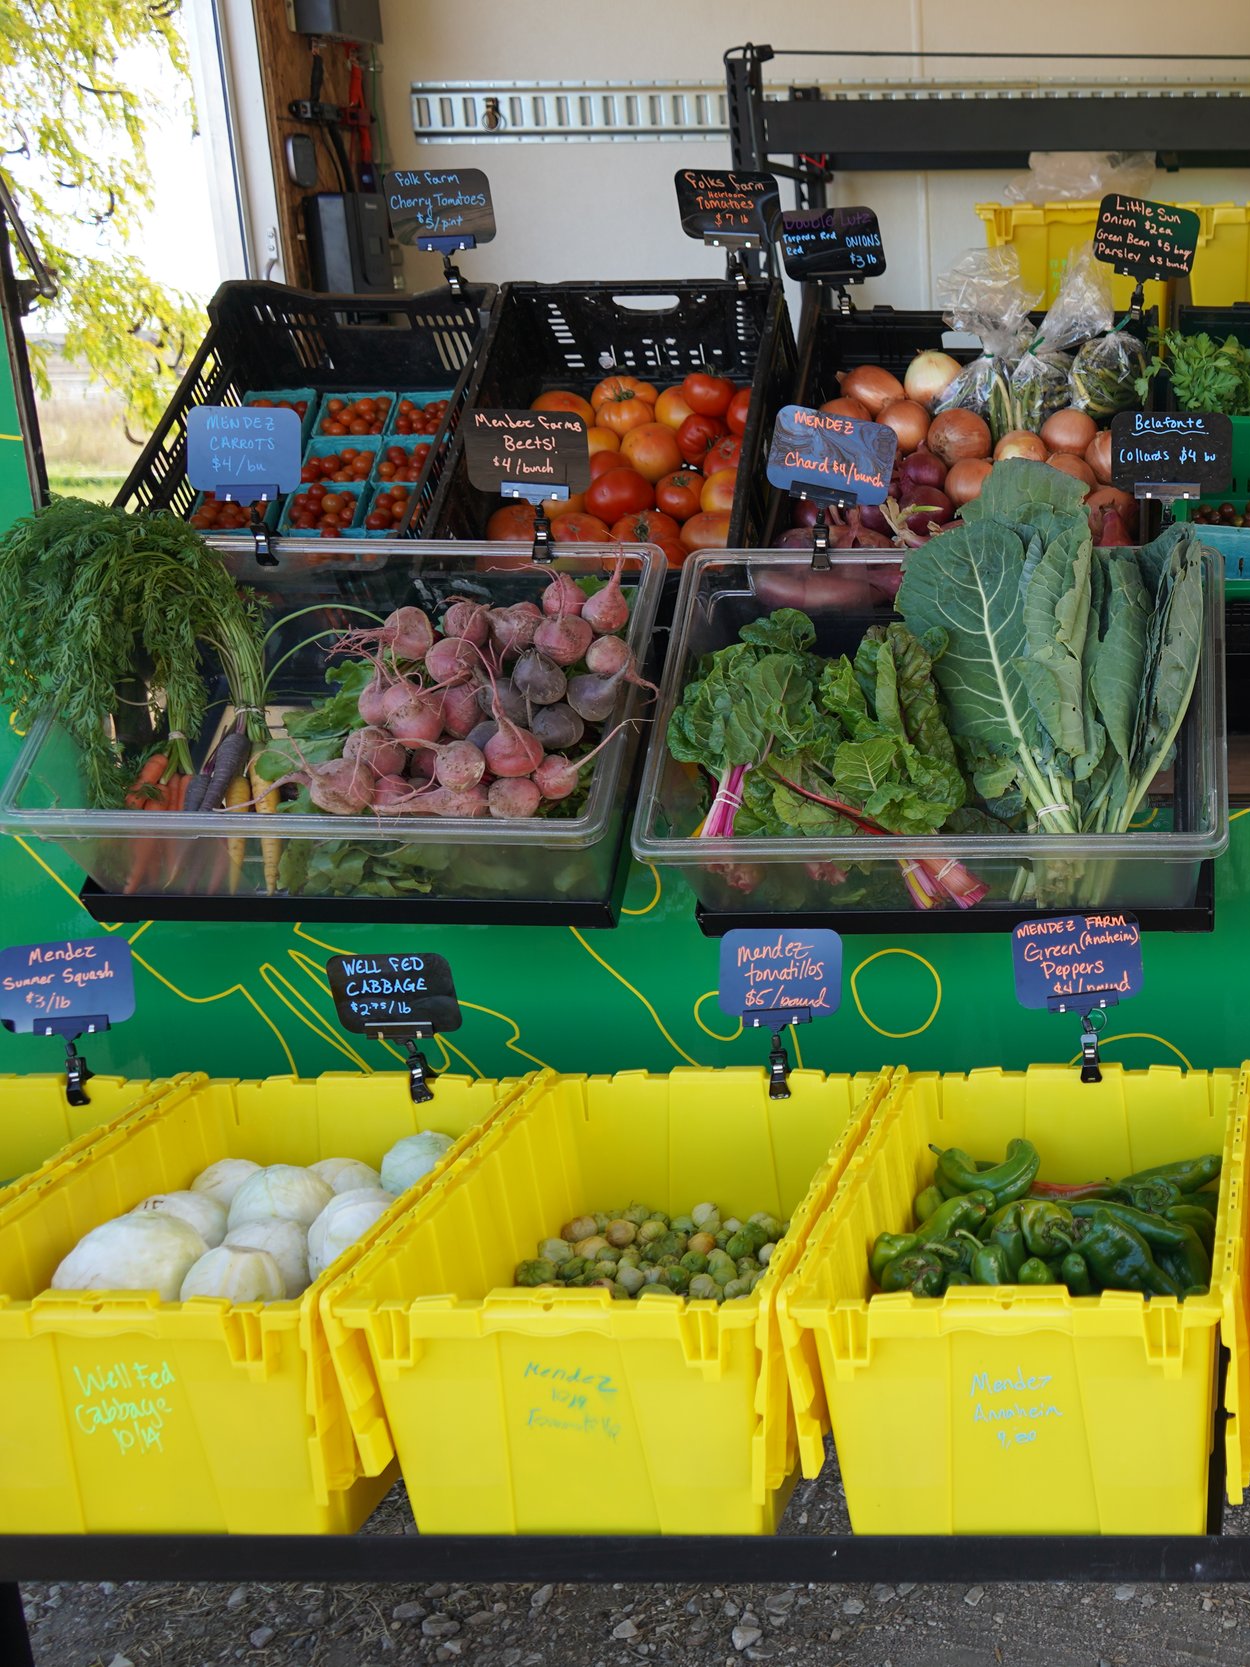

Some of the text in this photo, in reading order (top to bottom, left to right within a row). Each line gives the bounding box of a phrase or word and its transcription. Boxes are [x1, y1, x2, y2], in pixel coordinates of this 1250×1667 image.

[390, 194, 432, 218] Cherry
[433, 191, 486, 206] Tomatoes
[696, 196, 754, 210] Tomatoes
[1116, 195, 1182, 224] Little Sun
[1102, 212, 1137, 228] Onion
[845, 233, 881, 248] ONIONS
[1096, 228, 1151, 248] Green Bean
[866, 253, 877, 264] lb
[1098, 242, 1190, 272] Parsley $3 bunch
[1158, 240, 1193, 261] $5 bag
[206, 414, 275, 432] MENDEZ
[474, 412, 536, 429] Mendez
[793, 410, 855, 435] MENDEZ
[1134, 412, 1206, 431] Belafonte
[209, 435, 276, 452] CARROTS
[502, 433, 559, 455] Beets!
[784, 450, 830, 474] Chard
[1119, 445, 1217, 465] Collards $4 bu
[1016, 914, 1127, 939] MENDEZ FARM
[1023, 925, 1139, 962] Green (Anaheim)
[27, 942, 97, 967] Mendez
[2, 960, 114, 991] Summer Squash
[342, 956, 425, 977] WELL FED
[1040, 960, 1105, 980] Peppers
[346, 977, 428, 997] CABBAGE
[25, 991, 71, 1013] $3/lb
[73, 1360, 176, 1396] Well Fed
[969, 1365, 1053, 1398] Mendez
[75, 1396, 172, 1434] Cabbage
